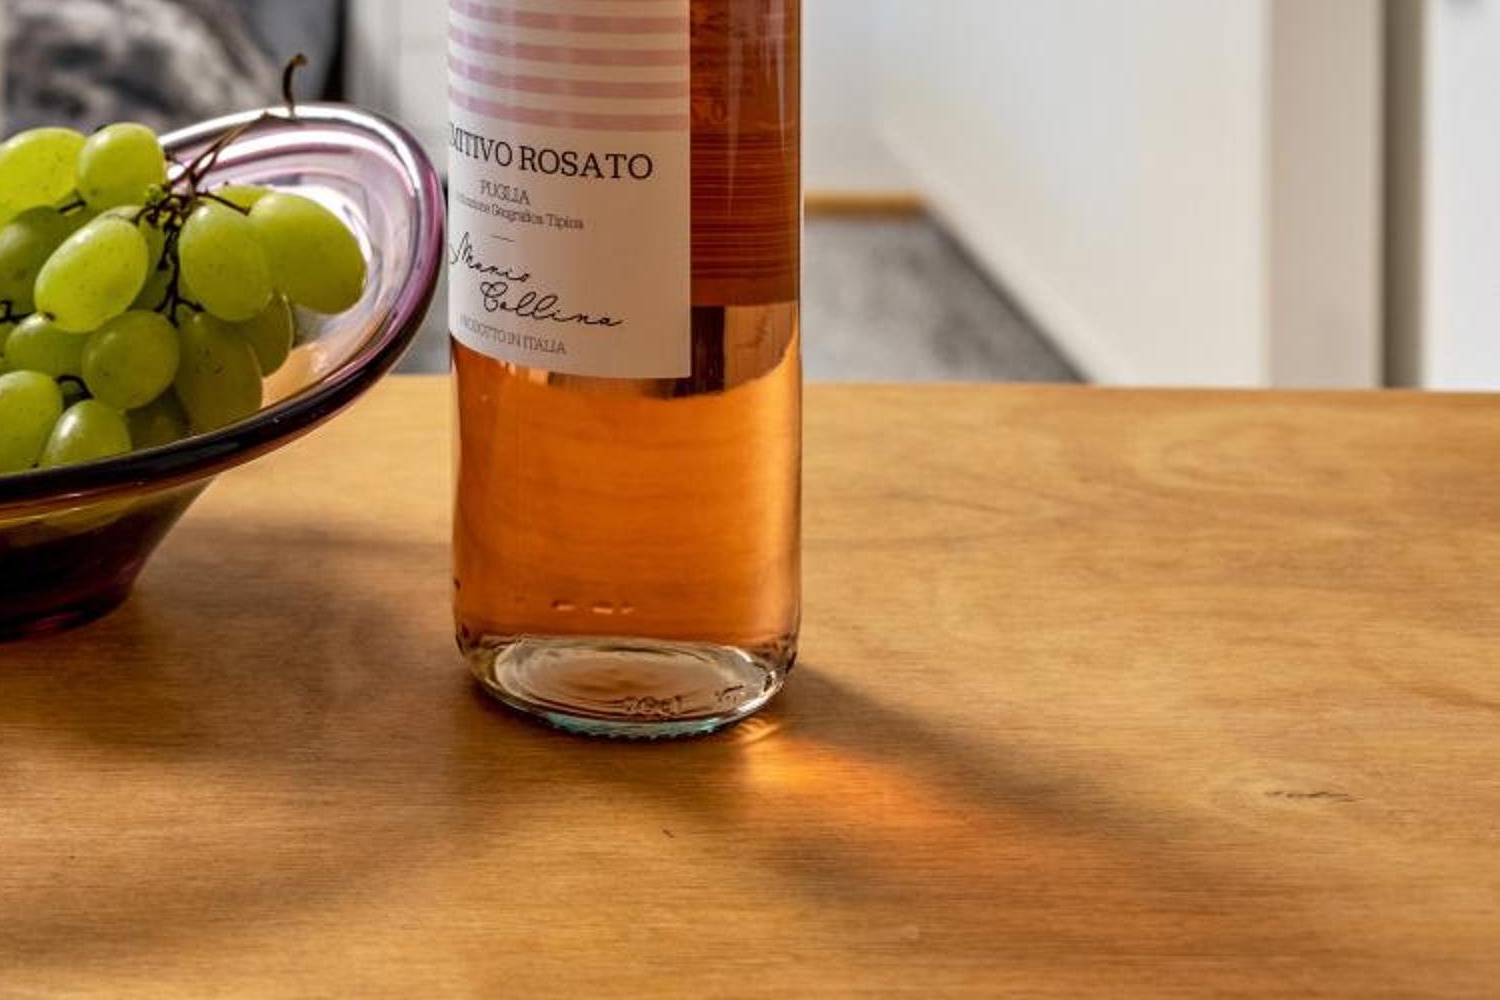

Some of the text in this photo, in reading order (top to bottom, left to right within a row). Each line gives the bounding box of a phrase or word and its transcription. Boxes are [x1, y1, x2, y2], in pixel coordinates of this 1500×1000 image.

[518, 145, 653, 179] ROSATO
[479, 179, 531, 206] PUGLIA
[479, 281, 624, 327] Collina
[523, 335, 567, 355] ITALIA
